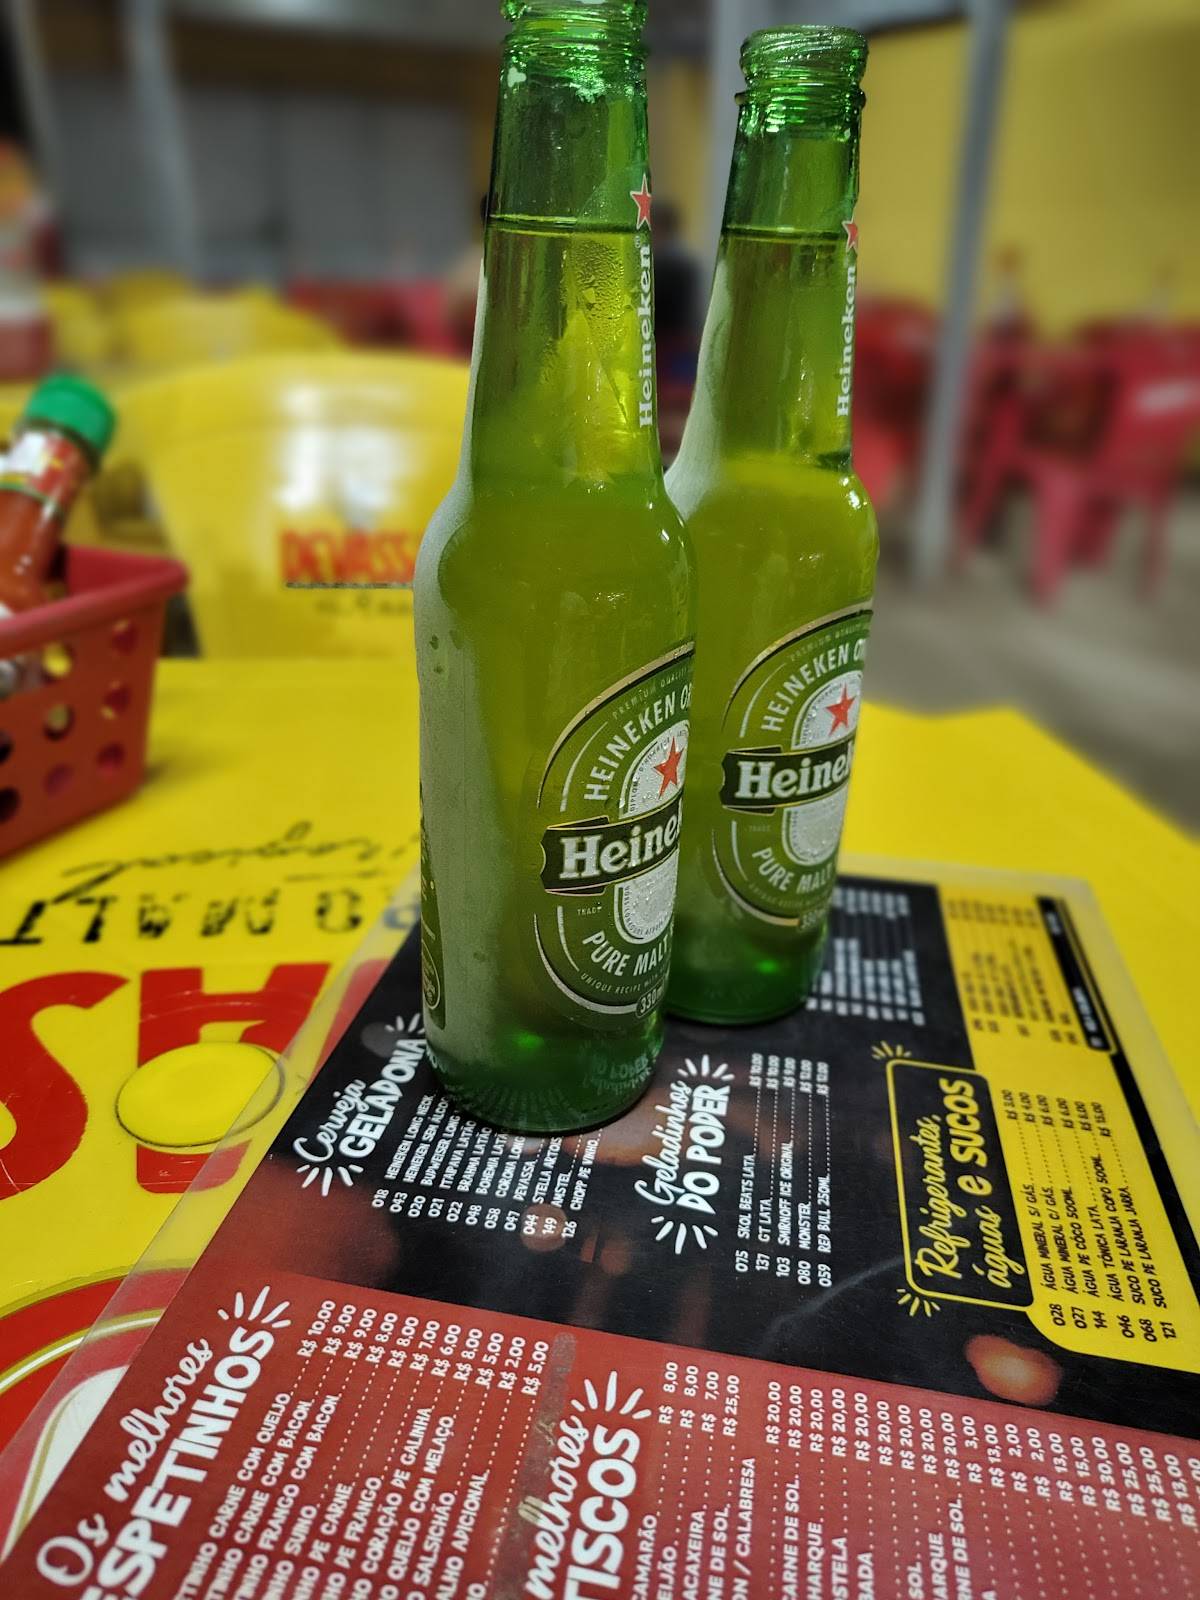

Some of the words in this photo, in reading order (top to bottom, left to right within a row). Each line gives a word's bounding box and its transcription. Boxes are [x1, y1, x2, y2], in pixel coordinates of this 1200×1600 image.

[637, 244, 653, 428] Heineken
[837, 266, 856, 417] Heineken
[761, 642, 850, 732] HEINEKEN
[583, 691, 677, 801] HEINEKEN
[558, 814, 679, 879] Heine
[751, 847, 795, 892] PURE
[796, 862, 833, 894] MALT
[581, 930, 631, 977] PURE
[633, 936, 668, 977] MALT
[339, 1038, 427, 1158] GELADONA
[293, 1078, 368, 1162] Cerveja
[686, 1084, 730, 1164] PODER
[939, 1077, 988, 1168] SUCOS
[371, 1188, 389, 1208] 018
[384, 1139, 413, 1179] HEINEKEN
[404, 1116, 423, 1139] LONG
[416, 1095, 433, 1116] NECK
[581, 1139, 599, 1165] VINHO
[634, 1080, 692, 1206] Geladinhos
[389, 1192, 408, 1212] 043
[402, 1142, 430, 1182] HEINEKEN
[421, 1124, 439, 1142] SEM
[407, 1195, 426, 1217] 020
[420, 1138, 452, 1186] BUDWEISER
[442, 1115, 460, 1138] LONG
[577, 1166, 591, 1179] DE
[742, 1154, 756, 1178] LATA
[779, 1142, 793, 1180] ORIGINAL
[1091, 1154, 1108, 1184] 500ML
[428, 1198, 444, 1217] 021
[438, 1149, 465, 1189] ITAIPAVA
[446, 1201, 463, 1222] 022
[456, 1156, 481, 1192] BRAHMA
[465, 1204, 482, 1225] 048
[475, 1156, 500, 1195] BOHEMIA
[484, 1207, 501, 1229] 058
[495, 1160, 517, 1198] CORONA
[503, 1210, 520, 1231] 047
[512, 1160, 538, 1201] DEVASSA
[522, 1214, 539, 1235] 044
[532, 1170, 552, 1204] STELLA
[543, 1137, 562, 1169] ARTOIS
[569, 1179, 587, 1210] CHOPP
[676, 1171, 720, 1215] DO
[738, 1179, 753, 1210] BEATS
[779, 1180, 792, 1197] ICE
[817, 1175, 830, 1206] 250ML
[957, 1174, 992, 1196] e
[1022, 1184, 1037, 1203] GÁS
[1041, 1187, 1056, 1206] GÁS
[1100, 1186, 1117, 1212] COPO
[1117, 1187, 1137, 1213] JARRA
[541, 1217, 557, 1235] 149
[550, 1172, 572, 1207] AMSTEL
[759, 1199, 772, 1224] LATA
[817, 1209, 830, 1232] BULL
[1061, 1188, 1079, 1219] 500ML
[1087, 1205, 1104, 1230] LATA
[561, 1221, 577, 1238] 126
[737, 1213, 752, 1239] SKOL
[757, 1225, 771, 1242] GT
[777, 1197, 791, 1246] SMIRNOFF
[797, 1202, 811, 1250] MONSTER
[1108, 1216, 1132, 1257] LARANJA
[1127, 1218, 1152, 1260] LARANJA
[817, 1233, 831, 1253] RED
[973, 1205, 1024, 1288] águas
[1031, 1221, 1050, 1259] MINERAL
[1051, 1224, 1071, 1262] MINERAL
[1094, 1233, 1115, 1268] TÔNICA
[735, 1250, 748, 1272] 075
[755, 1253, 770, 1270] 137
[775, 1256, 790, 1277] 103
[797, 1260, 811, 1284] 080
[817, 1263, 832, 1287] 059
[1040, 1263, 1058, 1290] ÁGUA
[1077, 1253, 1092, 1266] DE
[1120, 1259, 1136, 1272] DE
[1141, 1262, 1157, 1275] DE
[1060, 1266, 1079, 1294] ÁGUA
[1081, 1269, 1100, 1297] ÁGUA
[1105, 1273, 1124, 1301] ÁGUA
[1126, 1275, 1146, 1305] SUCO
[1147, 1278, 1167, 1308] SUCO
[1048, 1303, 1066, 1326] 028
[1070, 1306, 1087, 1329] 027
[1091, 1310, 1108, 1329] 144
[1116, 1314, 1135, 1338] 046
[1138, 1318, 1157, 1342] 068
[1159, 1321, 1176, 1339] 121
[418, 1320, 440, 1348] 7,00
[439, 1324, 461, 1355] 6,00
[527, 1341, 549, 1373] 5,00
[704, 1371, 720, 1400] 7,00
[724, 1375, 740, 1415] 25,00
[209, 1484, 246, 1537] CARNE
[236, 1446, 265, 1481] COM
[256, 1393, 293, 1443] QUEIJO
[307, 1300, 336, 1335] 10,00
[234, 1490, 270, 1544] CARNE
[260, 1451, 289, 1486] COM
[276, 1400, 314, 1448] BACON
[331, 1304, 356, 1334] 9,00
[257, 1484, 299, 1550] FRANGO
[290, 1445, 317, 1480] COM
[305, 1394, 341, 1442] BACON
[352, 1308, 377, 1338] 9,00
[283, 1505, 320, 1556] SUINO
[374, 1312, 398, 1343] 8,00
[308, 1539, 331, 1562] DE
[320, 1483, 354, 1535] CARNE
[396, 1316, 419, 1347] 8,00
[387, 1518, 420, 1580] QUEIJO
[409, 1477, 434, 1513] COM
[423, 1416, 456, 1474] MELAÇO
[460, 1328, 482, 1360] 8,00
[400, 1408, 434, 1466] GALINHA
[451, 1474, 488, 1552] ADICIONAL
[504, 1336, 526, 1368] 2,00
[1048, 1433, 1068, 1473] 13,00
[36, 1513, 109, 1587] Os
[103, 1338, 213, 1502] melhores
[79, 1326, 275, 1600] SPETINHOS
[412, 1492, 457, 1586] SALSICHÃO
[481, 1332, 504, 1364] 5,00
[1139, 1446, 1164, 1495] 25,00
[390, 1468, 411, 1489] DE
[344, 1477, 384, 1542] FRANGO
[518, 1415, 589, 1600] melhores
[735, 1458, 755, 1557] CALABRESA
[784, 1482, 799, 1513] SOL
[361, 1492, 402, 1573] CORAÇÃO
[712, 1506, 730, 1543] SOL
[783, 1515, 798, 1541] DE
[334, 1545, 356, 1568] DE
[709, 1545, 726, 1572] DE
